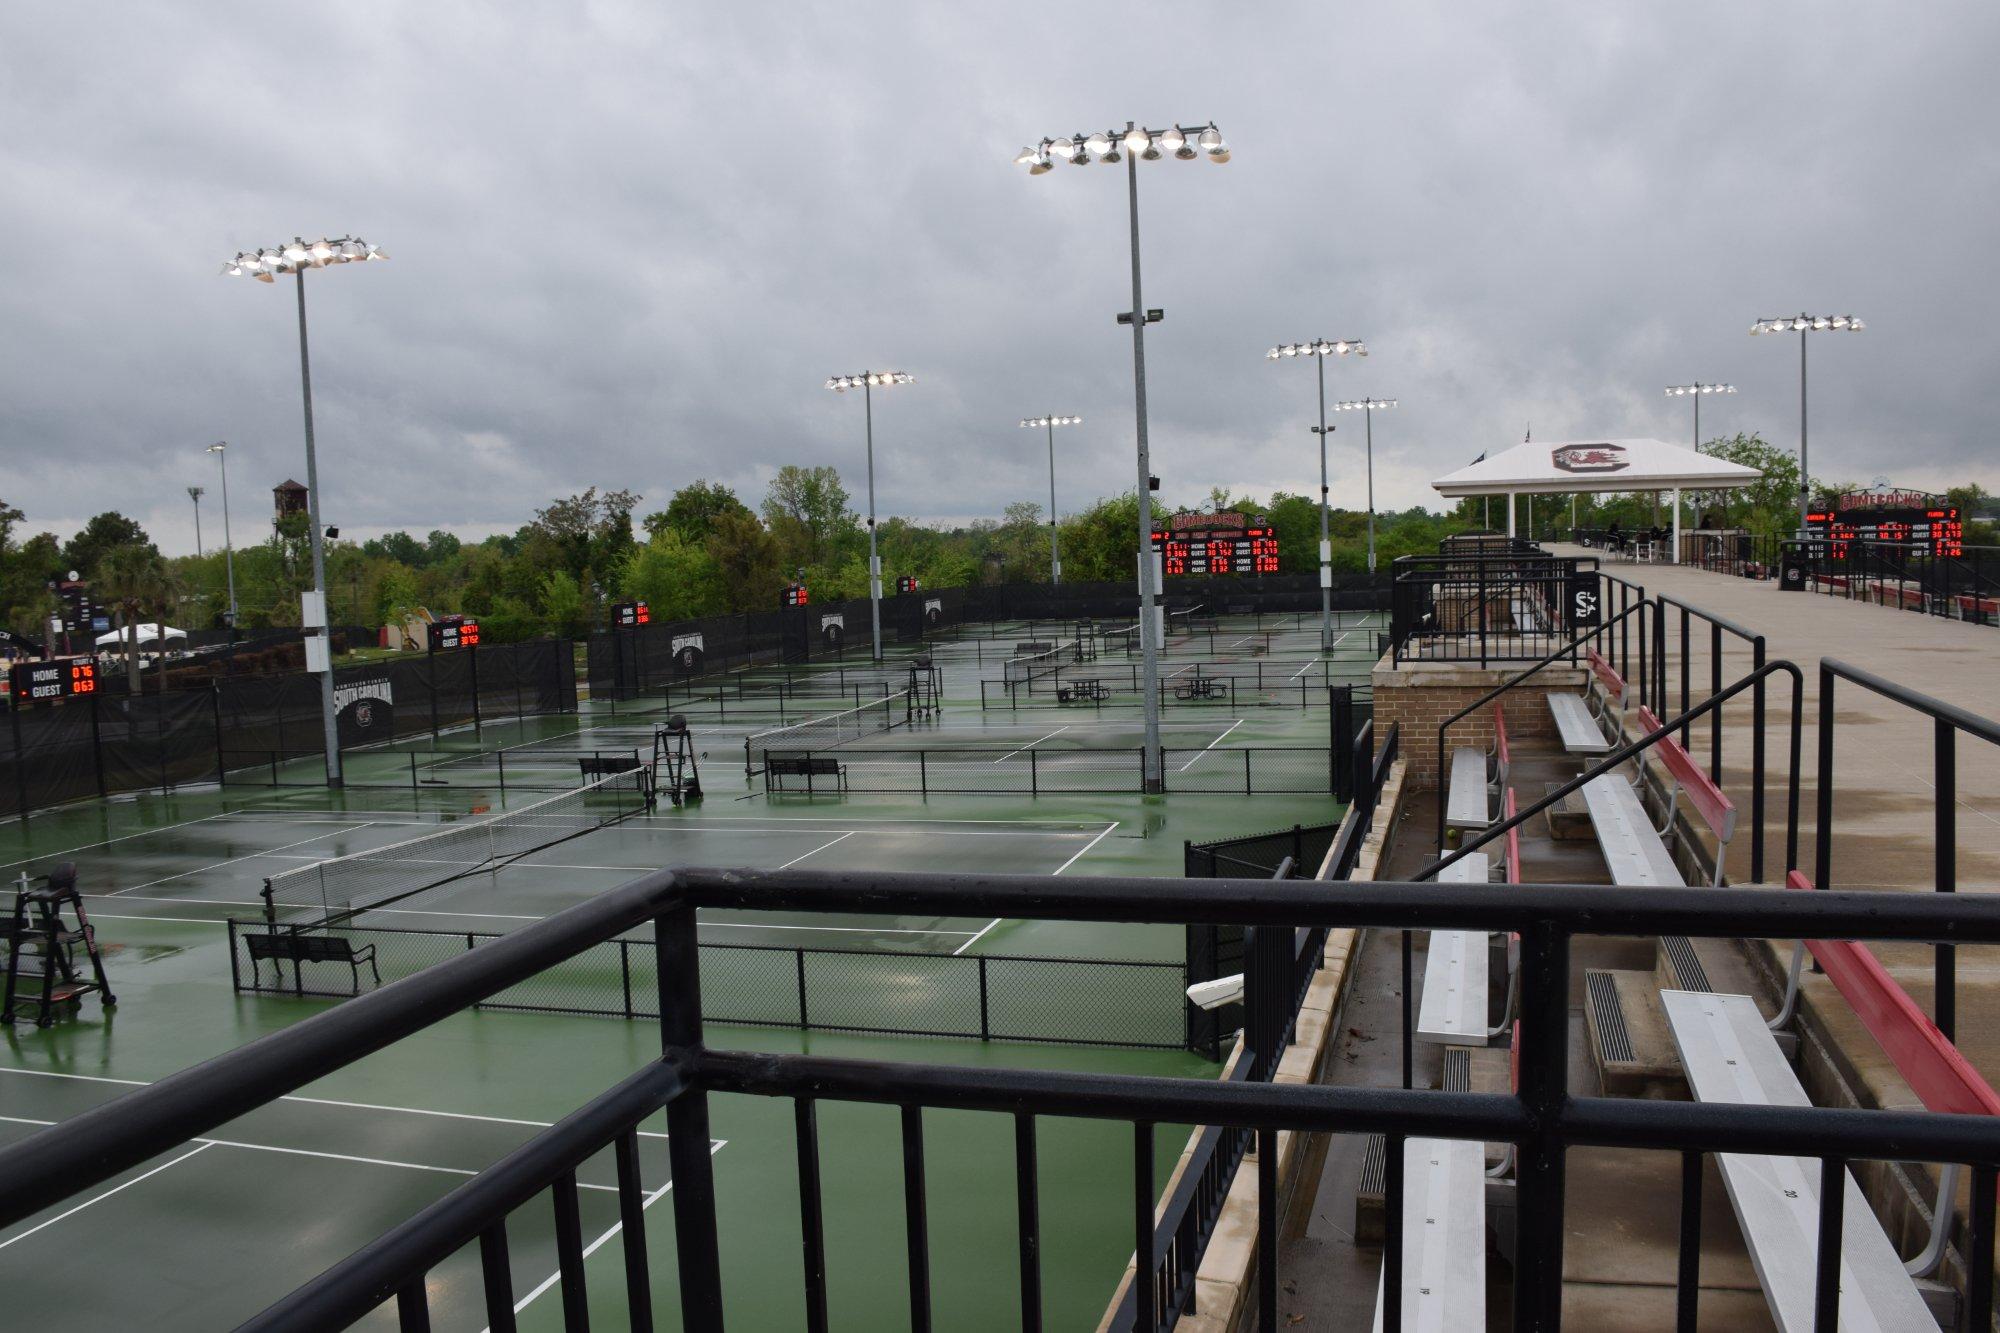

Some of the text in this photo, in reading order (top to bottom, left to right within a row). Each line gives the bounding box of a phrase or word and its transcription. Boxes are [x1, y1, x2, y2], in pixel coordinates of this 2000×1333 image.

[1840, 493, 1922, 511] GAMECOCKS
[1828, 512, 1835, 521] 2
[1950, 509, 1957, 518] 2
[1267, 528, 1273, 536] 2
[442, 628, 457, 637] HOME
[442, 638, 458, 648] GUEST
[32, 669, 59, 682] HOME
[32, 684, 61, 698] GUEST
[334, 682, 393, 715] SOUTH CAROLINA
